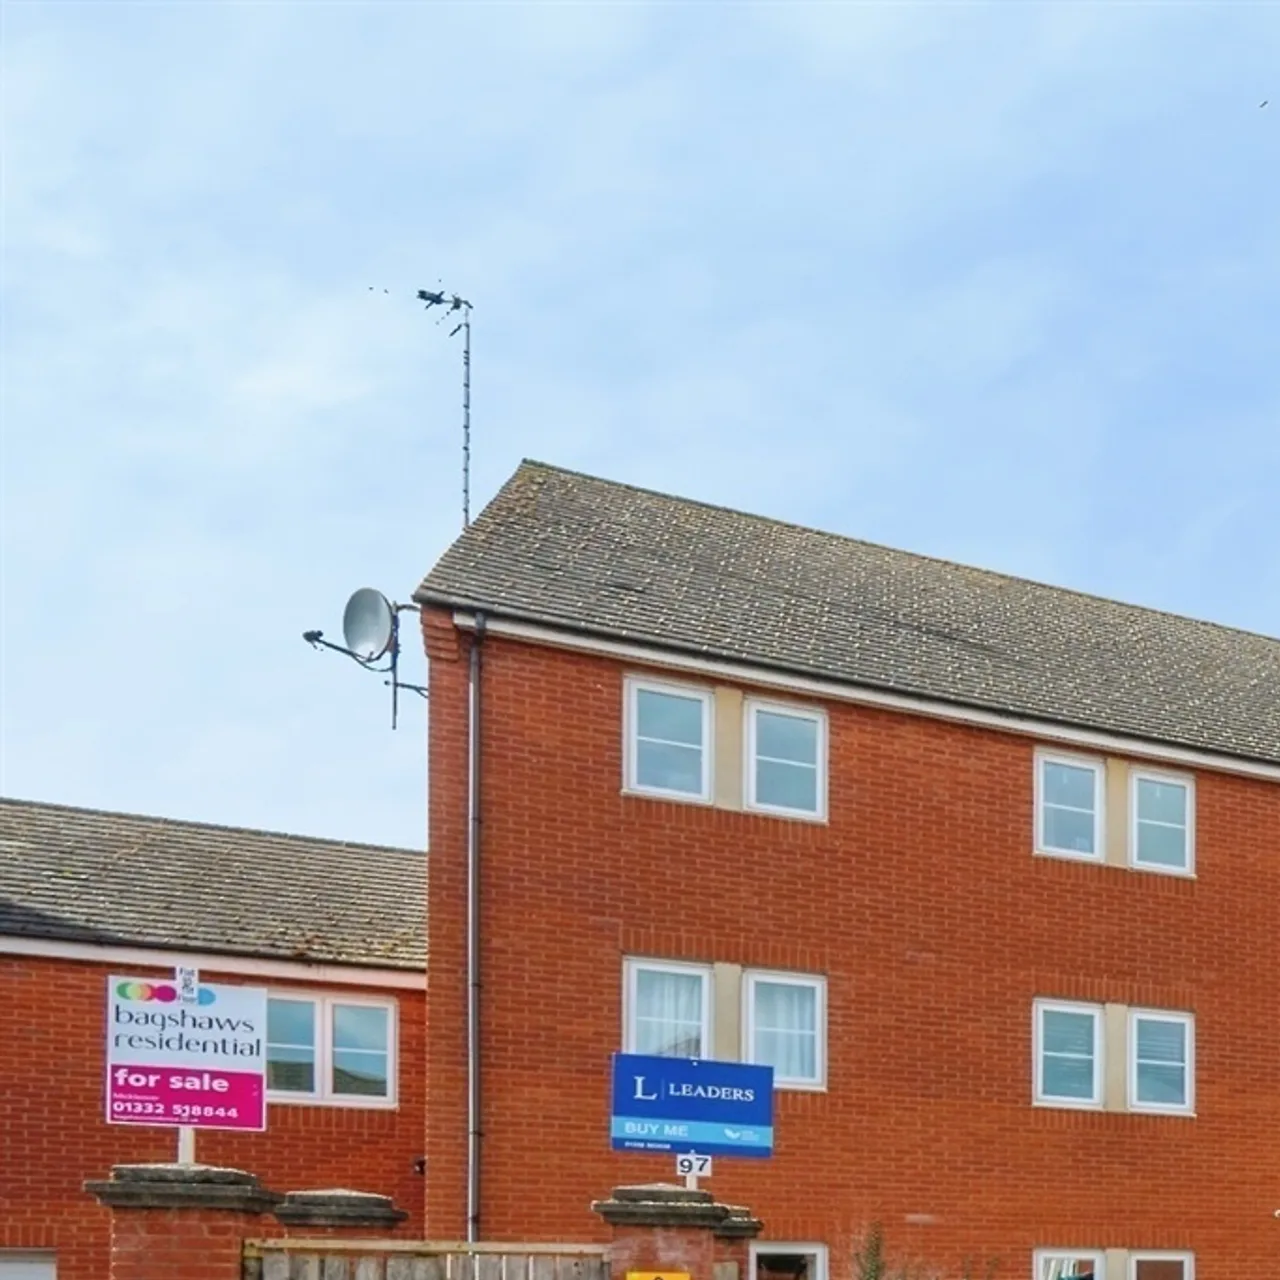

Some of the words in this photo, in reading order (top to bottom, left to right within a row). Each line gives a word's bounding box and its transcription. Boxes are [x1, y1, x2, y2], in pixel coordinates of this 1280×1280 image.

[115, 1004, 255, 1034] bagshaws
[114, 1032, 261, 1057] residential
[114, 1068, 161, 1088] for
[169, 1073, 229, 1092] sale
[633, 1076, 657, 1100] L
[669, 1083, 755, 1101] LEADERS
[113, 1101, 165, 1114] 01332
[624, 1121, 659, 1136] BUY
[663, 1124, 689, 1137] ME
[679, 1157, 709, 1174] 97
